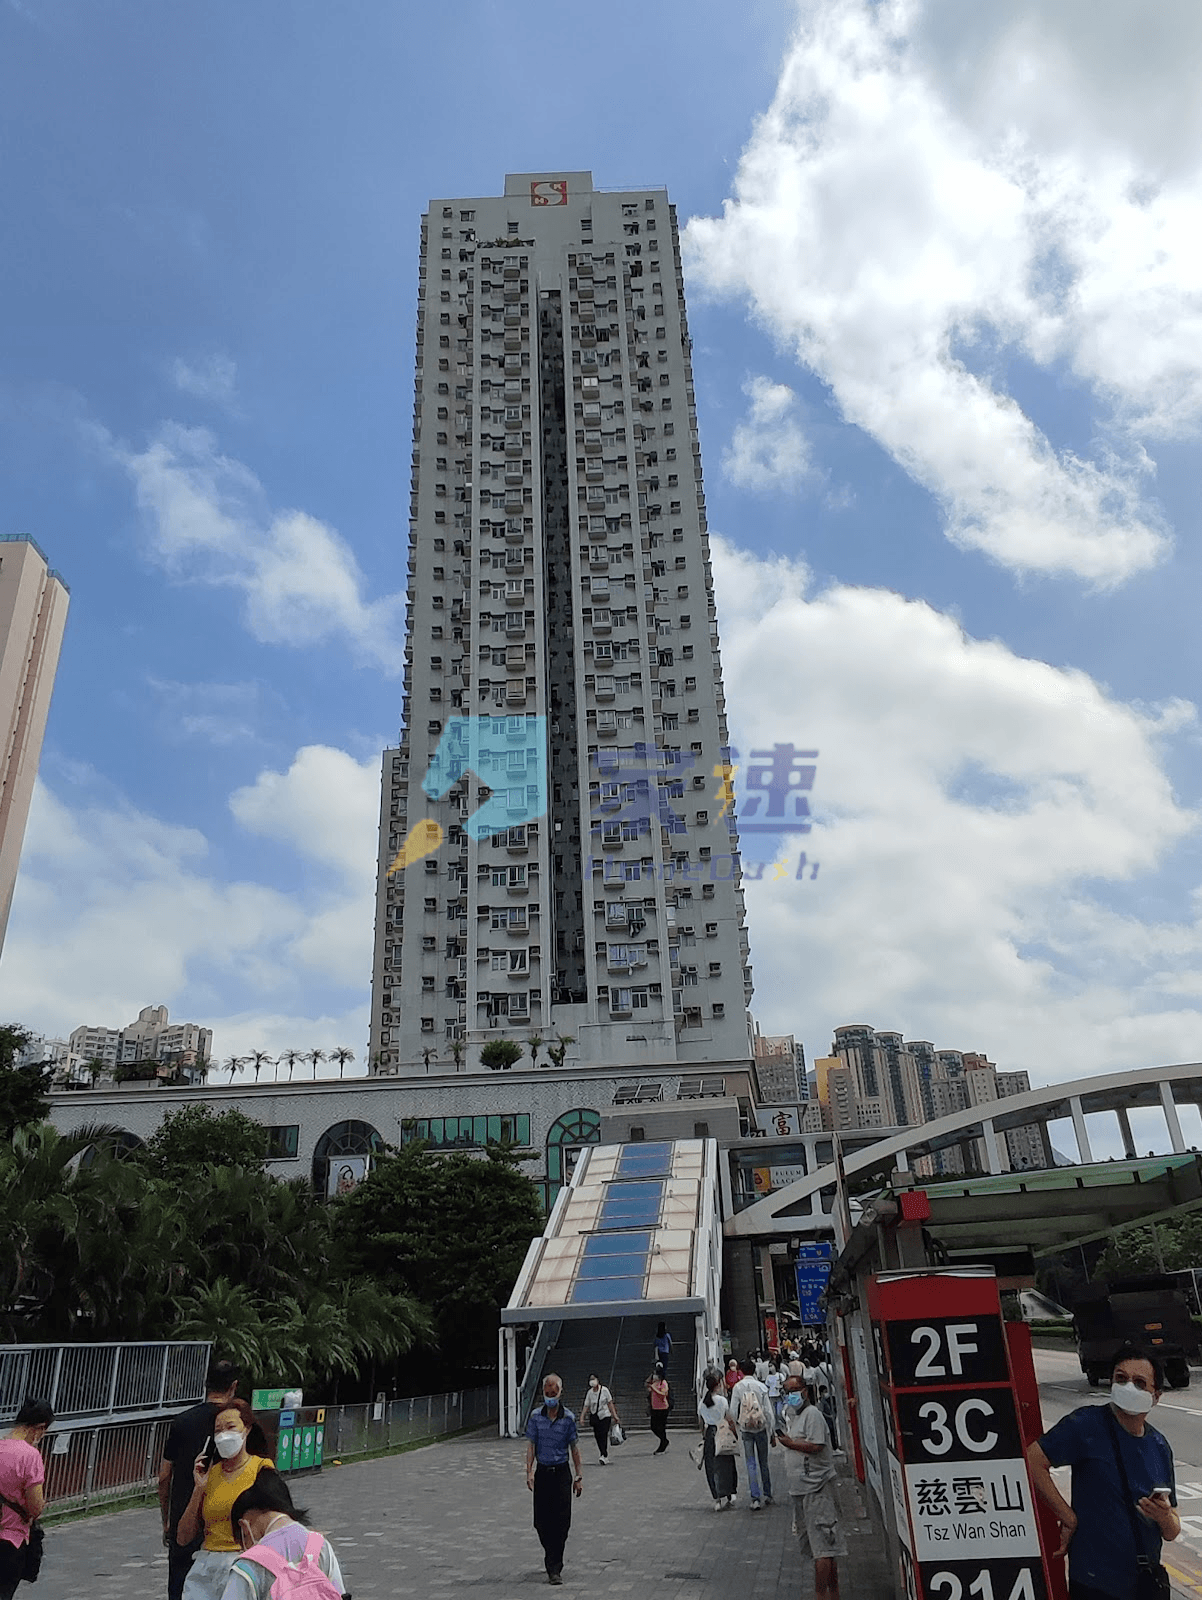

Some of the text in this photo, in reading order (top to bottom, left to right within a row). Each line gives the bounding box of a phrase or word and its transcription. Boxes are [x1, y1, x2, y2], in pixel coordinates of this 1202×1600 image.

[771, 1110, 793, 1136] 富
[910, 1323, 979, 1378] 2F
[918, 1398, 999, 1456] 3C
[914, 1474, 1026, 1516] 慈雲山
[923, 1521, 1027, 1541] Tsz Wan Shan
